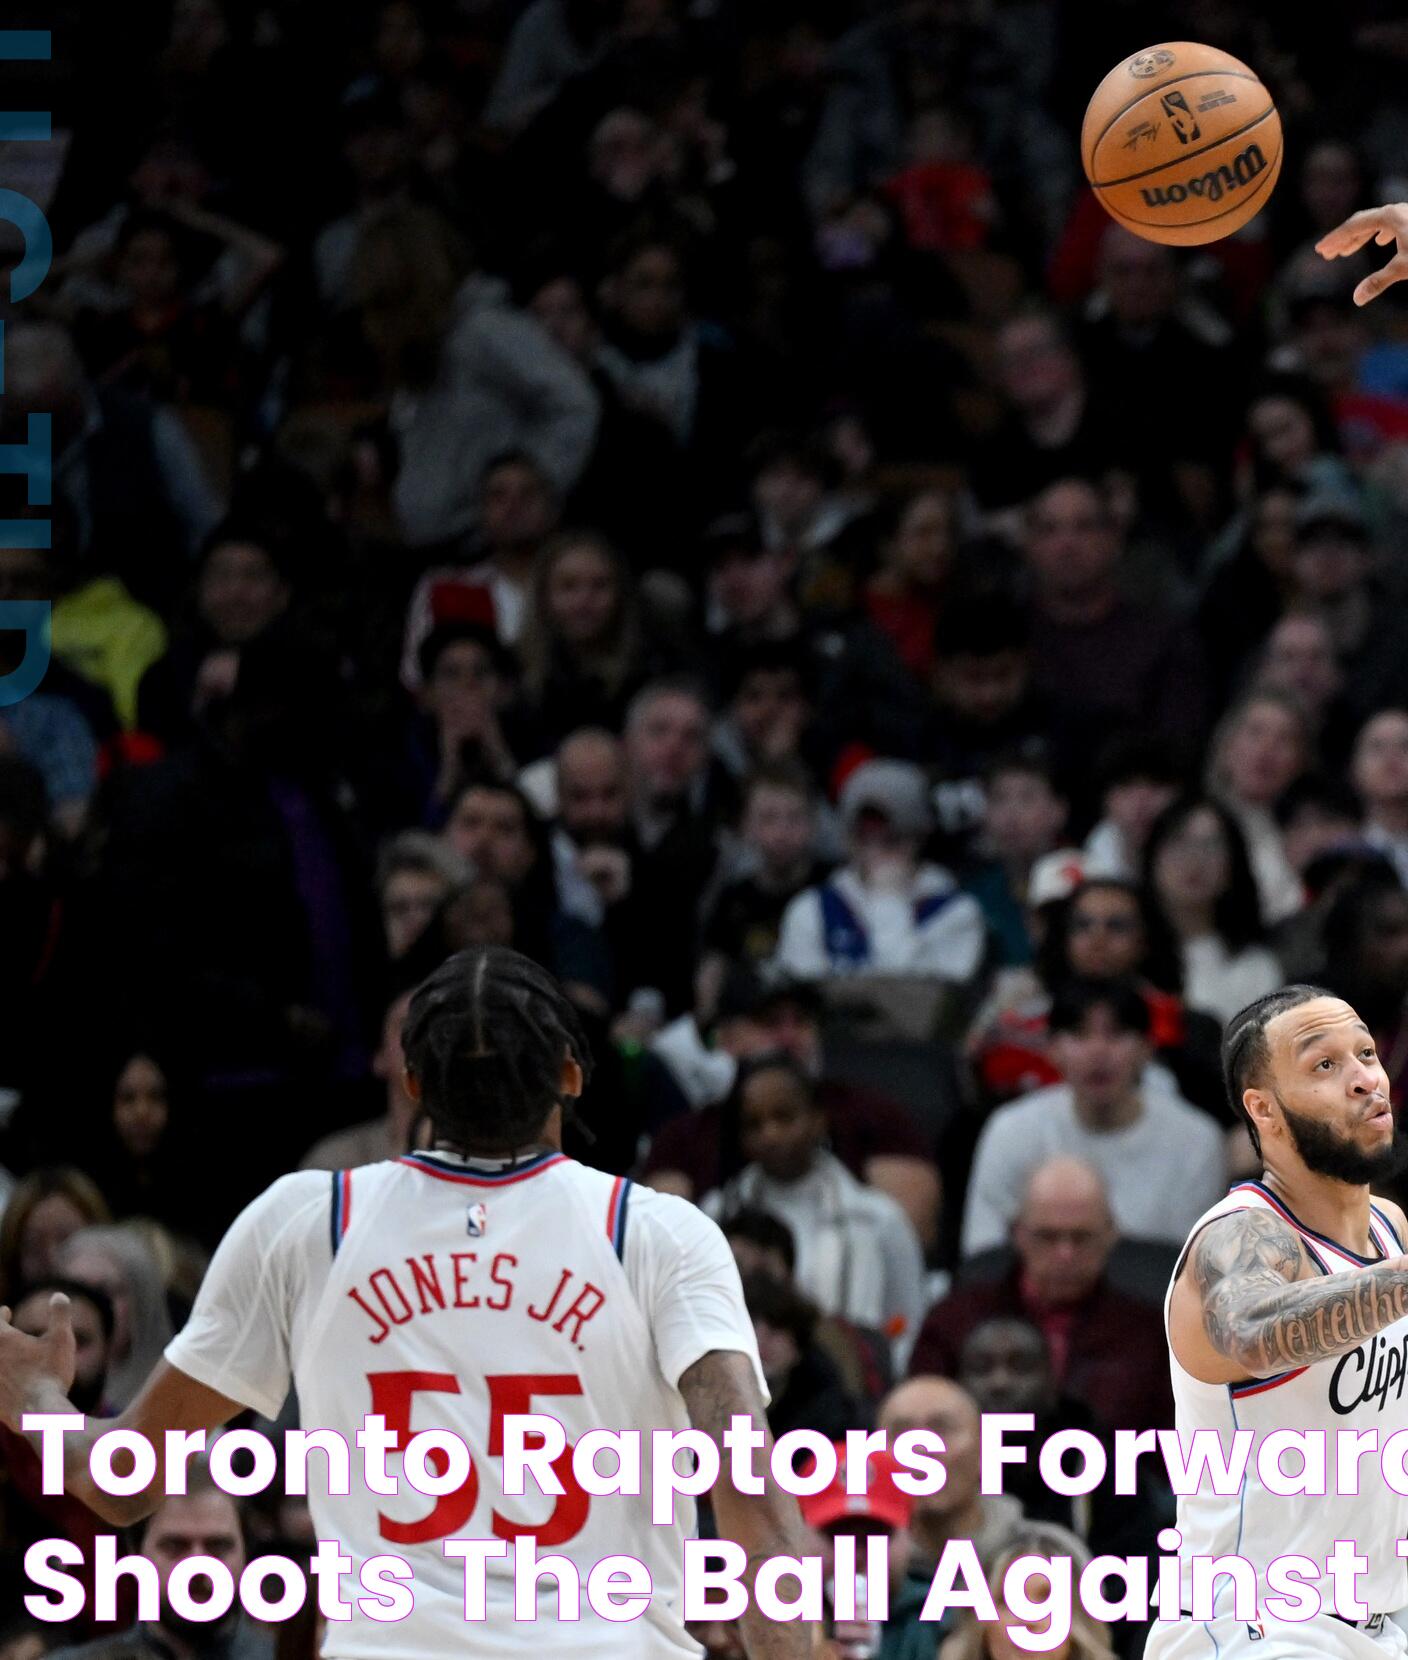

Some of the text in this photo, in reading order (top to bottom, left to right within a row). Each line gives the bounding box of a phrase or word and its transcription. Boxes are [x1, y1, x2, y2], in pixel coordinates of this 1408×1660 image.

[1138, 144, 1267, 208] Wilson
[347, 1253, 606, 1352] JONES JR.
[366, 1371, 591, 1547] 55
